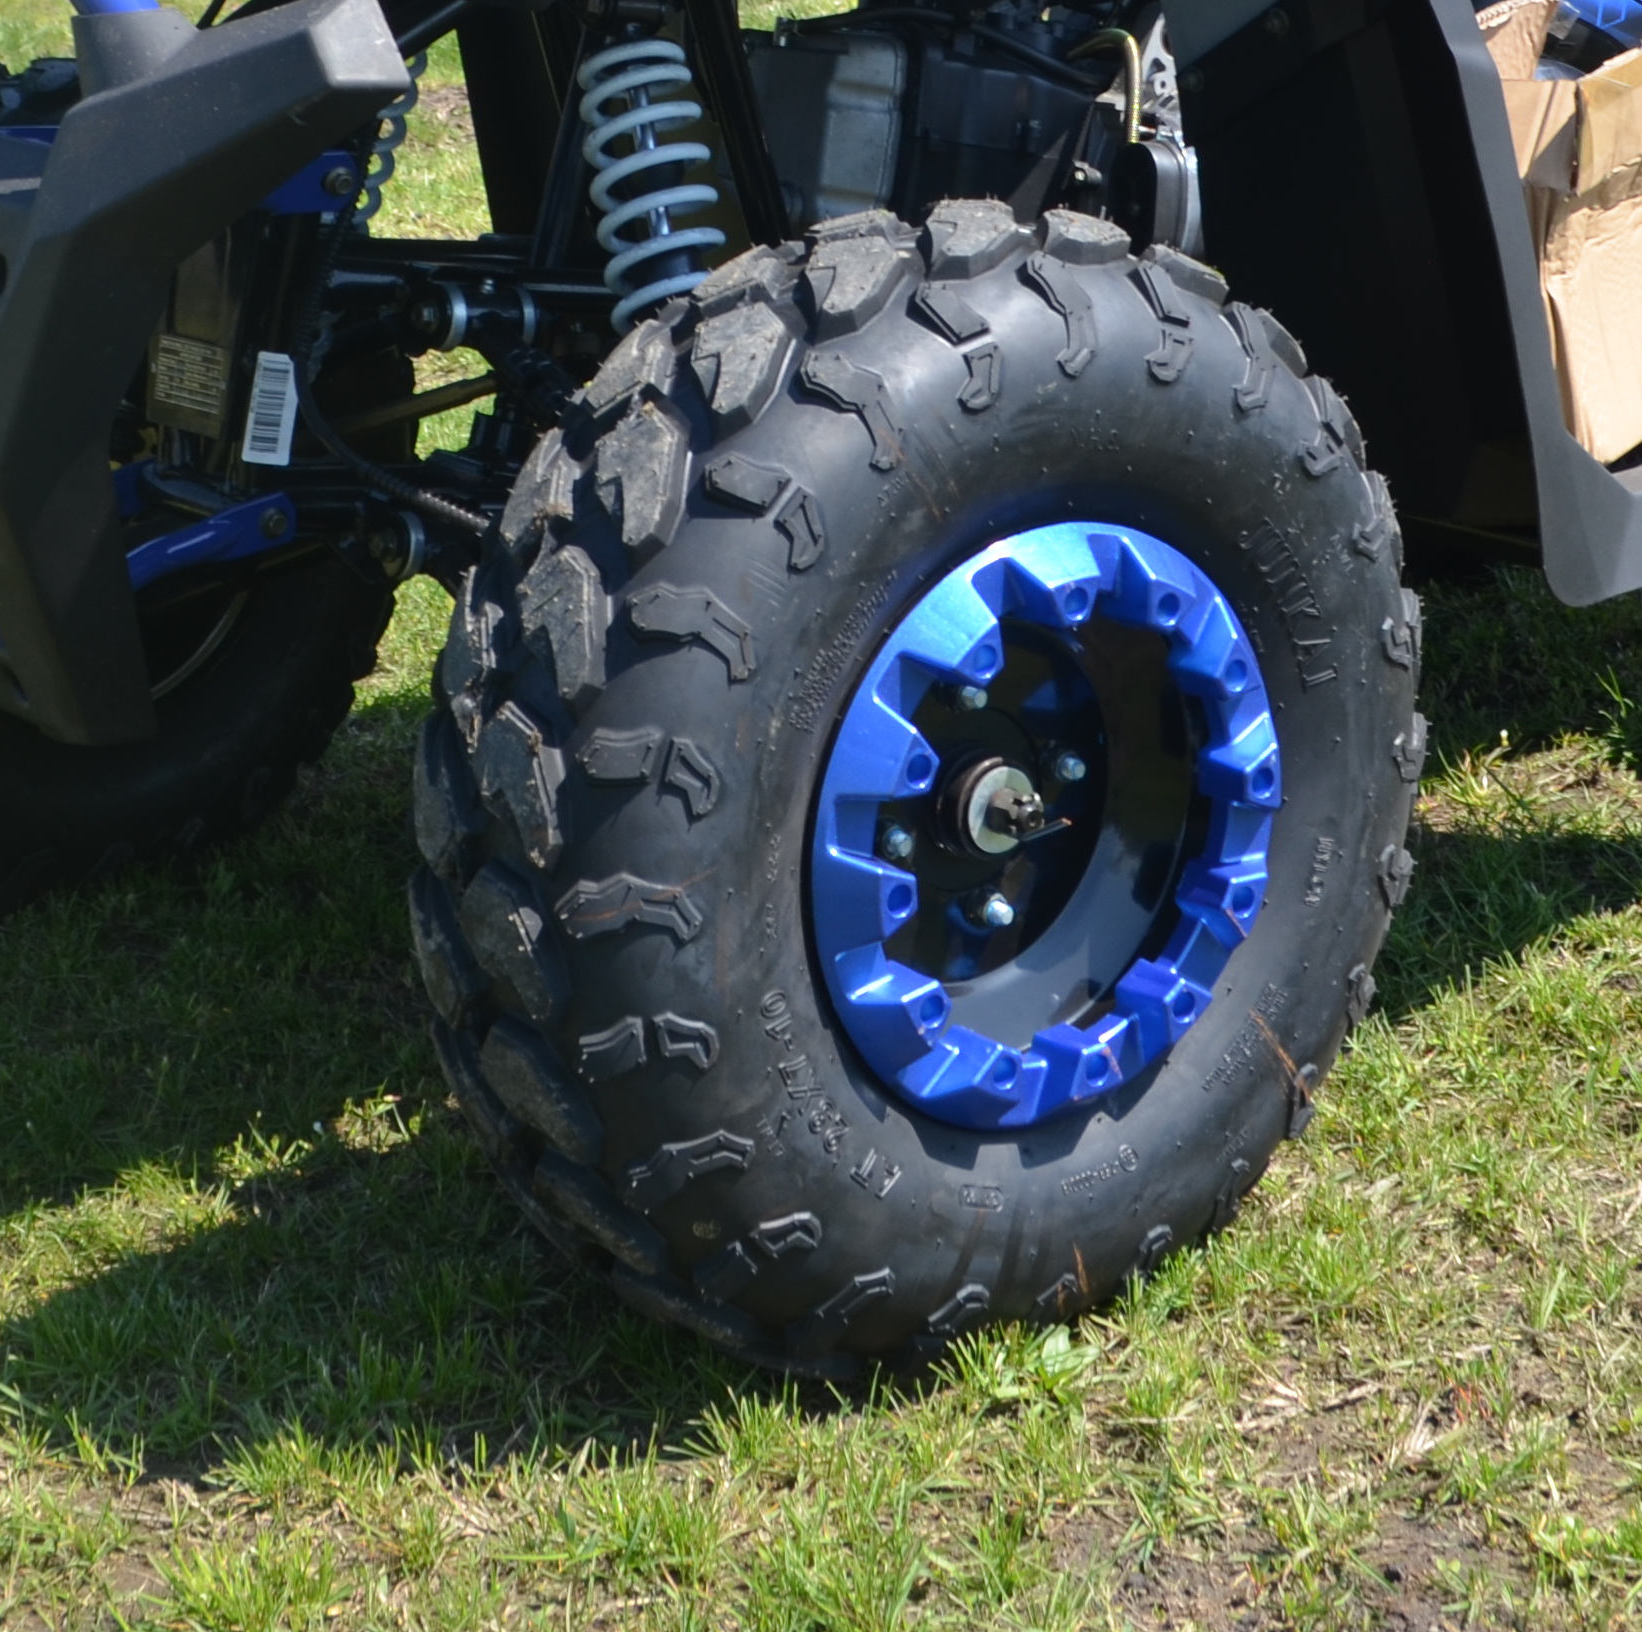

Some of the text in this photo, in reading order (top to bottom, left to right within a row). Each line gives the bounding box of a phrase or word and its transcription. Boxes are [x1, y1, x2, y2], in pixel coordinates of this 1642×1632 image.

[1238, 516, 1338, 691] JUNKAI
[761, 989, 903, 1200] AT 23X7-10
